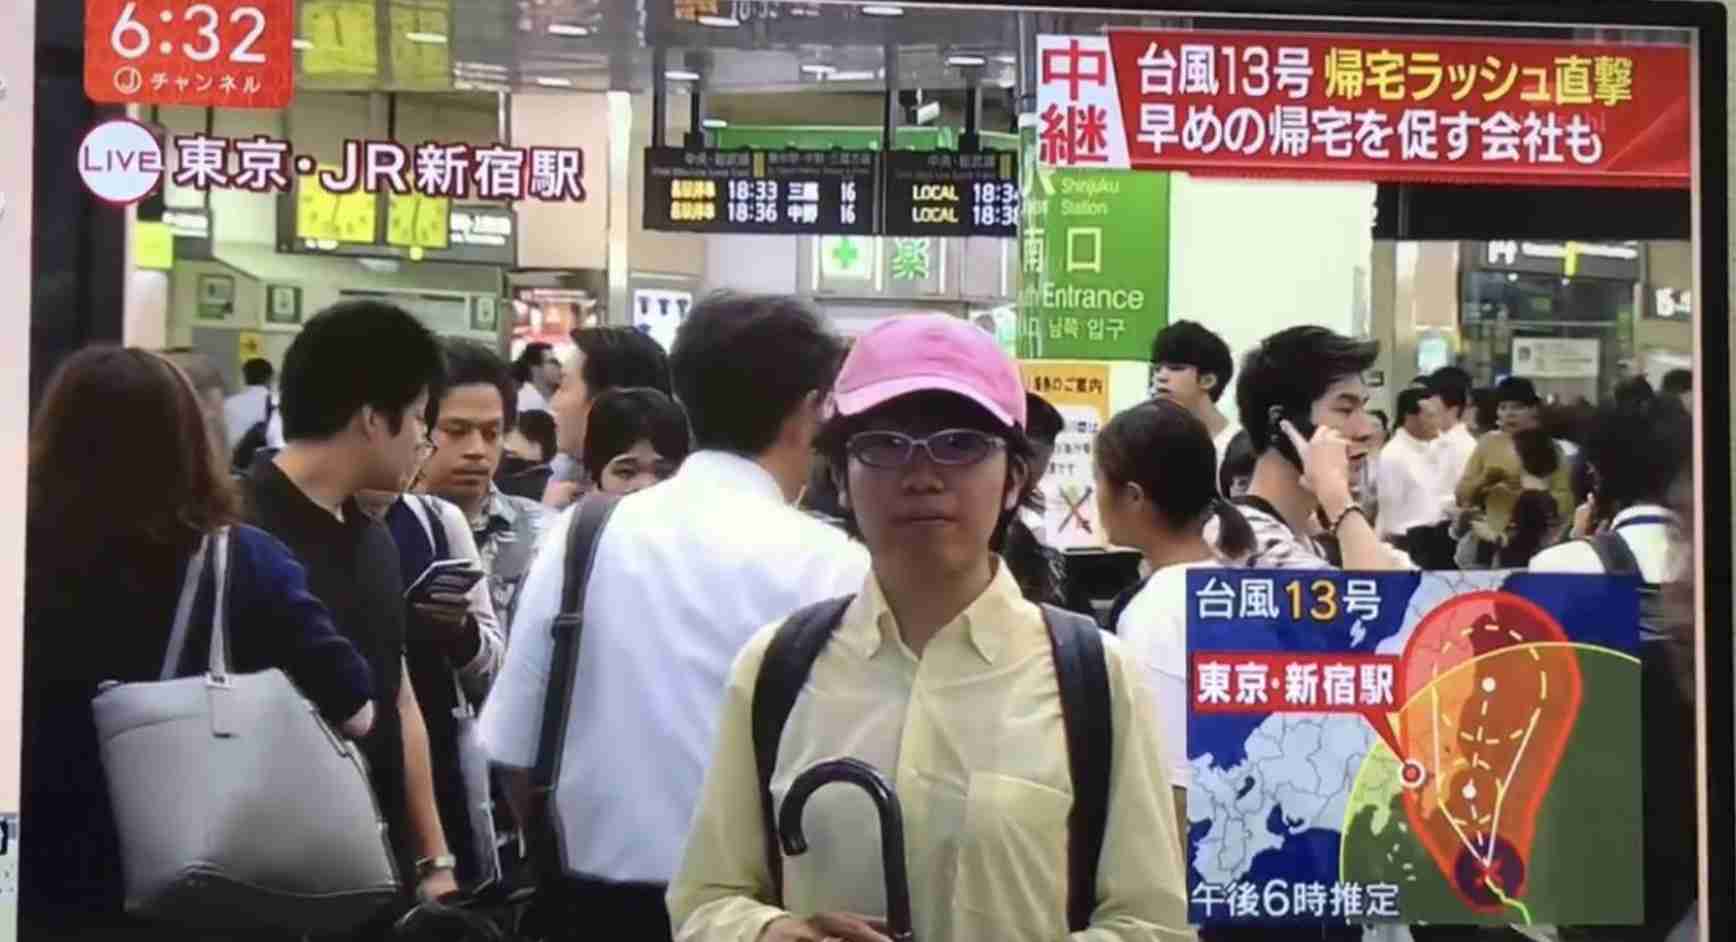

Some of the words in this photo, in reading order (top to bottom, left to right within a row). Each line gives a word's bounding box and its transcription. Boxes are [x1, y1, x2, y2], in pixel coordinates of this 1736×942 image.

[110, 2, 267, 63] 6:32
[1136, 41, 1314, 99] 台風13号
[1324, 47, 1634, 107] 帰宅ラッシュ直撃
[1039, 38, 1109, 166] 中継
[1136, 102, 1604, 165] 早めの帰宅を促す会社も
[83, 146, 161, 172] LIVE
[175, 134, 584, 199] 東京・JR新宿駅
[727, 179, 779, 200] 18:33
[840, 182, 857, 200] 16
[911, 184, 959, 201] LOCAL
[1060, 177, 1120, 196] Shinjuku
[727, 201, 779, 223] 18:36
[840, 204, 857, 224] 16
[911, 206, 959, 223] LOCAL
[1060, 200, 1109, 216] Station
[1042, 283, 1145, 310] Entrance
[1196, 577, 1382, 621] 台風13号
[1197, 660, 1394, 706] 東京・新宿駅
[1191, 878, 1400, 918] 午後6時推定
